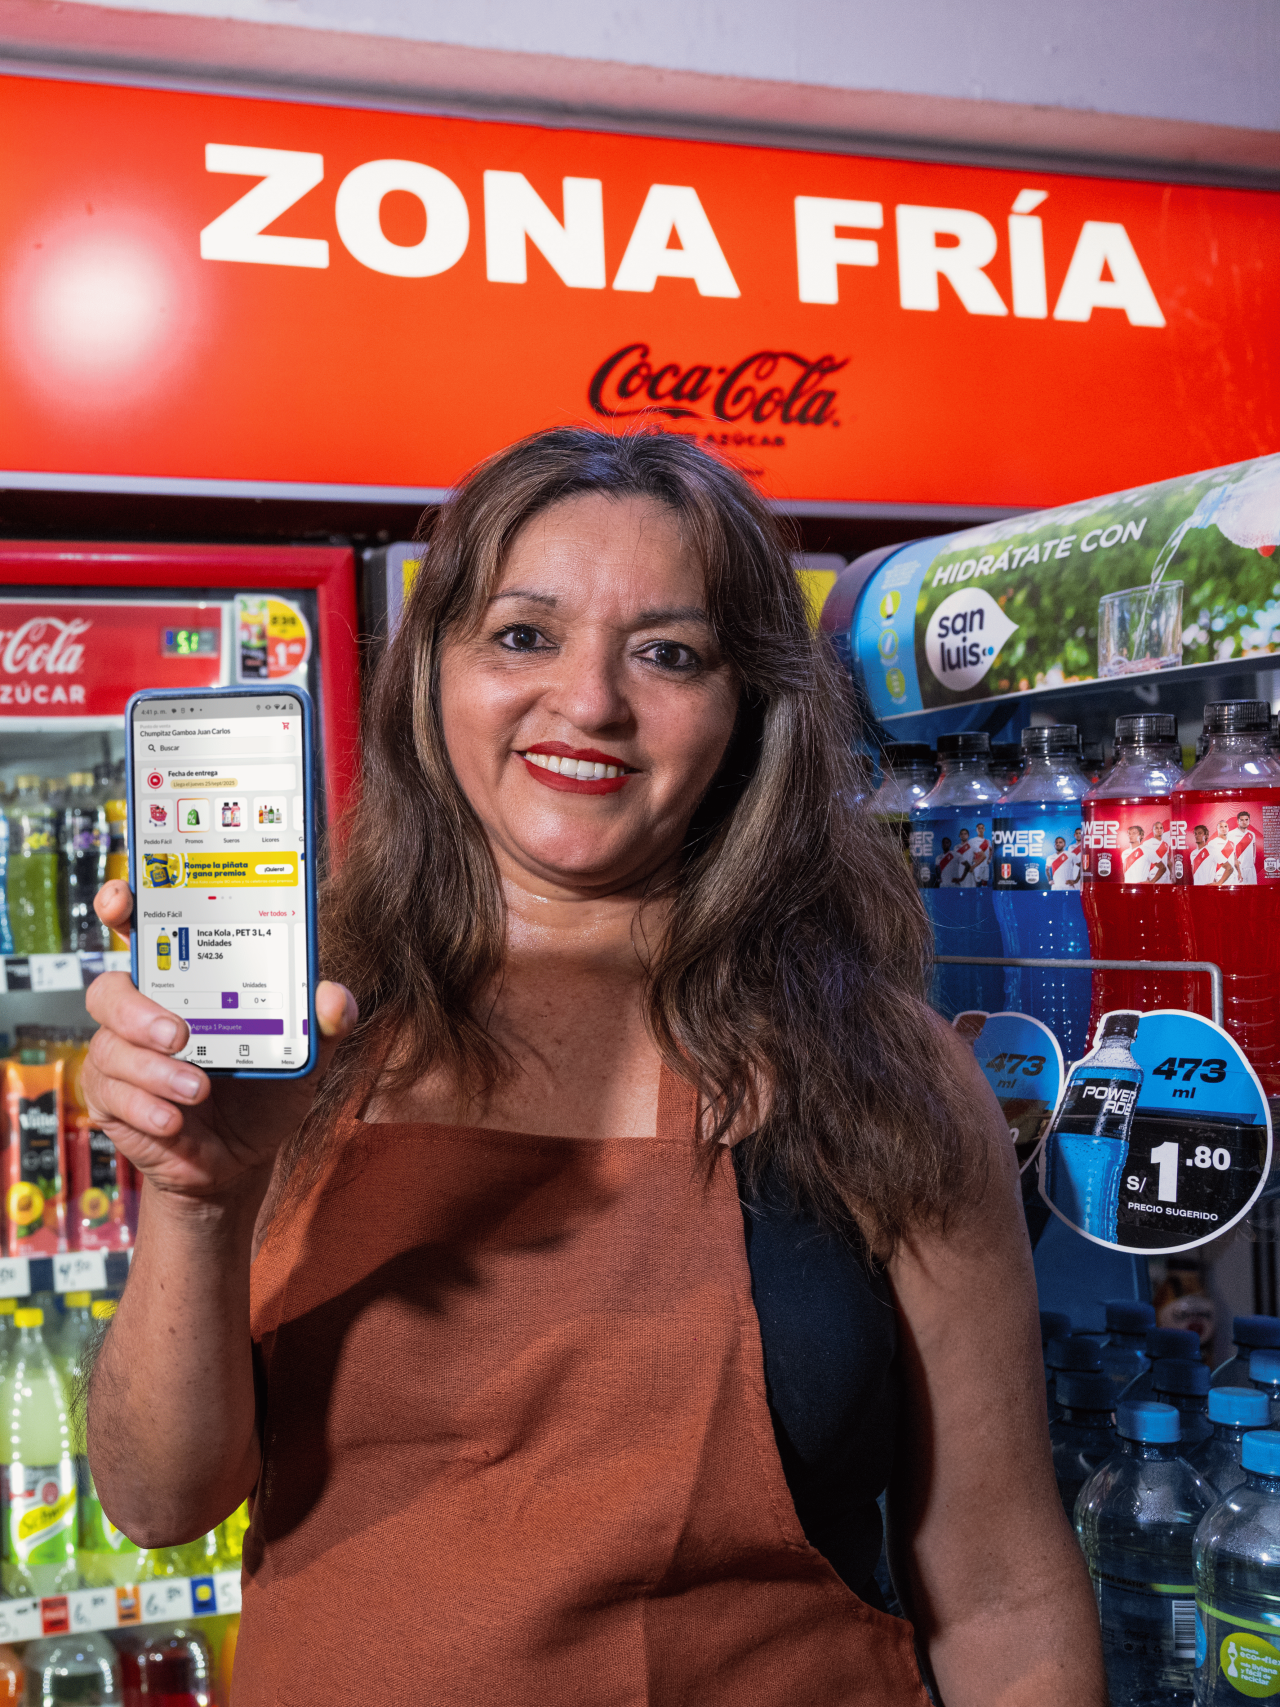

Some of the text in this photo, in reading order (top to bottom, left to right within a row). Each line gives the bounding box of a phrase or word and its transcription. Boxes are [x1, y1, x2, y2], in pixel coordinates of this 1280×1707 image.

[199, 142, 1167, 328] ZONA FRÍA
[931, 534, 1077, 588] HIDRÁTATE
[1080, 517, 1148, 553] CON
[937, 608, 985, 639] san
[940, 636, 981, 672] luis
[1002, 843, 1043, 857] ADE
[184, 862, 212, 870] Rompe
[222, 861, 249, 870] piñata
[214, 869, 246, 878] premios
[197, 929, 213, 937] Inca
[214, 929, 231, 937] Kola
[236, 928, 251, 937] PET
[252, 929, 257, 937] 3
[258, 929, 266, 938] L,
[266, 928, 272, 937] 4
[197, 939, 232, 947] Unidades
[197, 952, 224, 960] S/42.36
[985, 1052, 1047, 1077] 473
[1152, 1057, 1228, 1084] 473
[1082, 1085, 1137, 1102] POWER
[1171, 1086, 1197, 1099] ml
[1102, 1100, 1133, 1116] ADE
[1128, 1202, 1219, 1222] PRECIO SUGERIDO
